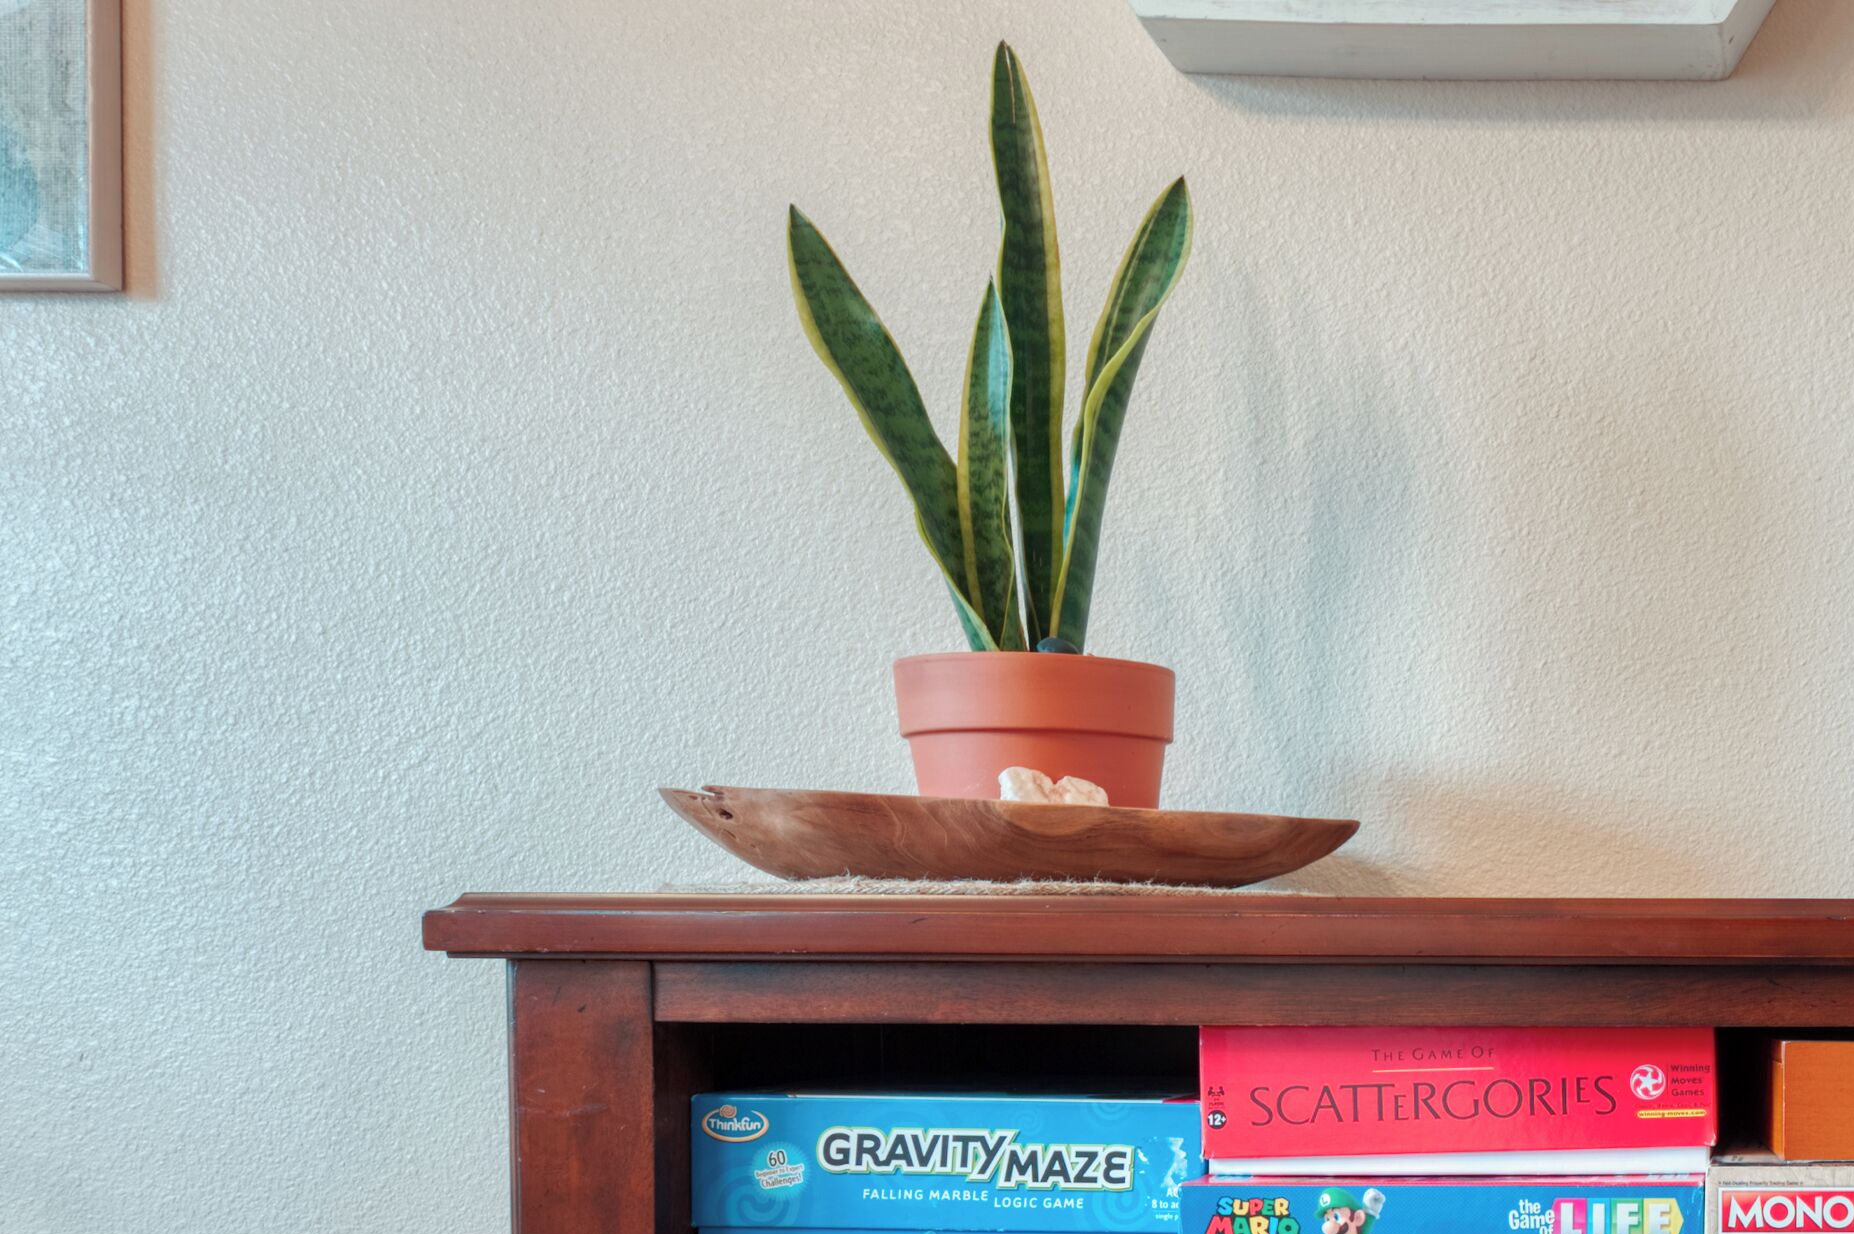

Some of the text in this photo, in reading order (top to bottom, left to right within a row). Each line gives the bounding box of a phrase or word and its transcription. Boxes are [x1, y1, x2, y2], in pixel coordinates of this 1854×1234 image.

[1371, 1045, 1495, 1061] THE GAME OF
[1670, 1064, 1711, 1073] Winning
[1671, 1077, 1703, 1085] Moves
[1250, 1075, 1617, 1126] SCATTERGORIES
[1671, 1088, 1704, 1097] Games
[1207, 1113, 1227, 1126] 12+
[768, 1150, 786, 1167] 60
[821, 1131, 1128, 1184] GRAVITY MAZE
[862, 1189, 1084, 1209] FALLING MARBLE LOGIC GAME
[1151, 1199, 1158, 1209] 8
[1159, 1199, 1169, 1209] to
[1217, 1196, 1290, 1216] SUPER
[1518, 1199, 1541, 1214] the
[1508, 1209, 1555, 1230] Game
